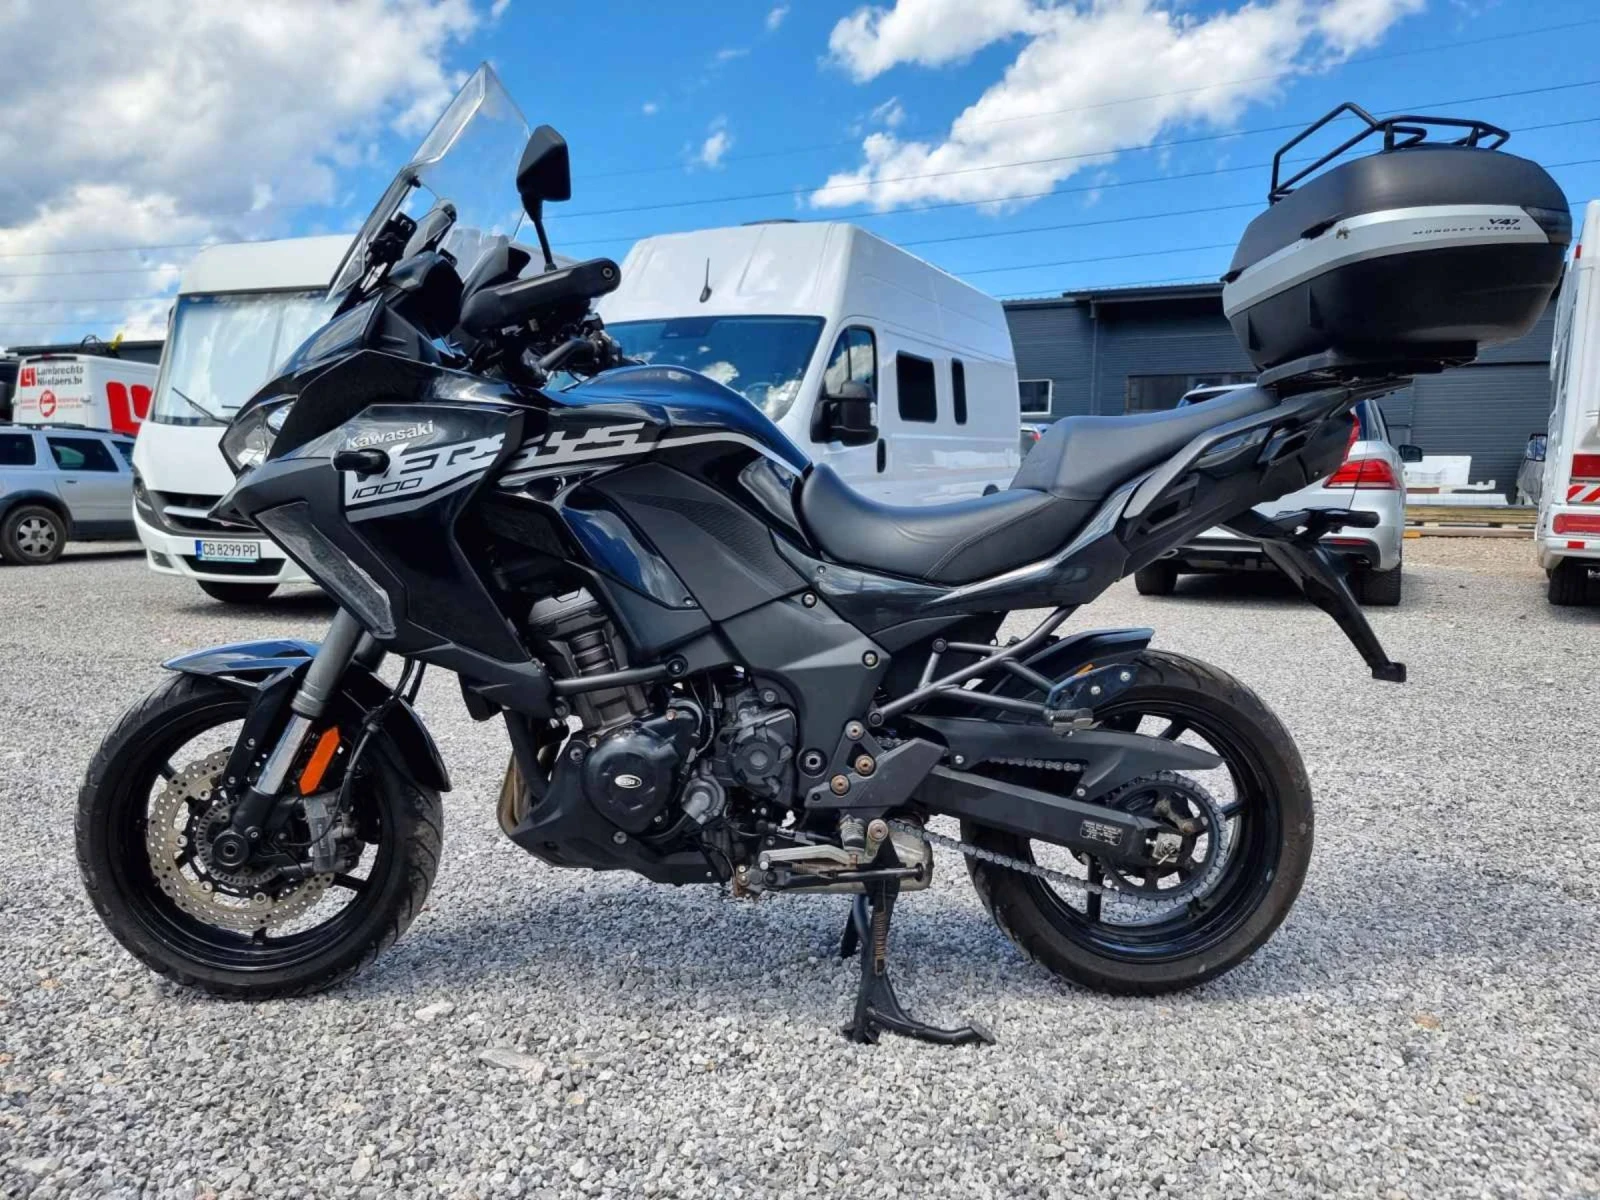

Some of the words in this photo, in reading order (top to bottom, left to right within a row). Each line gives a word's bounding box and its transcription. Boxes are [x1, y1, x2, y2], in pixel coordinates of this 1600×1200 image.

[37, 366, 84, 375] Lambrechts
[346, 420, 434, 449] Kawasaki
[352, 478, 423, 500] 1000
[203, 543, 215, 555] CB
[217, 544, 241, 557] 8299
[243, 545, 256, 557] PP
